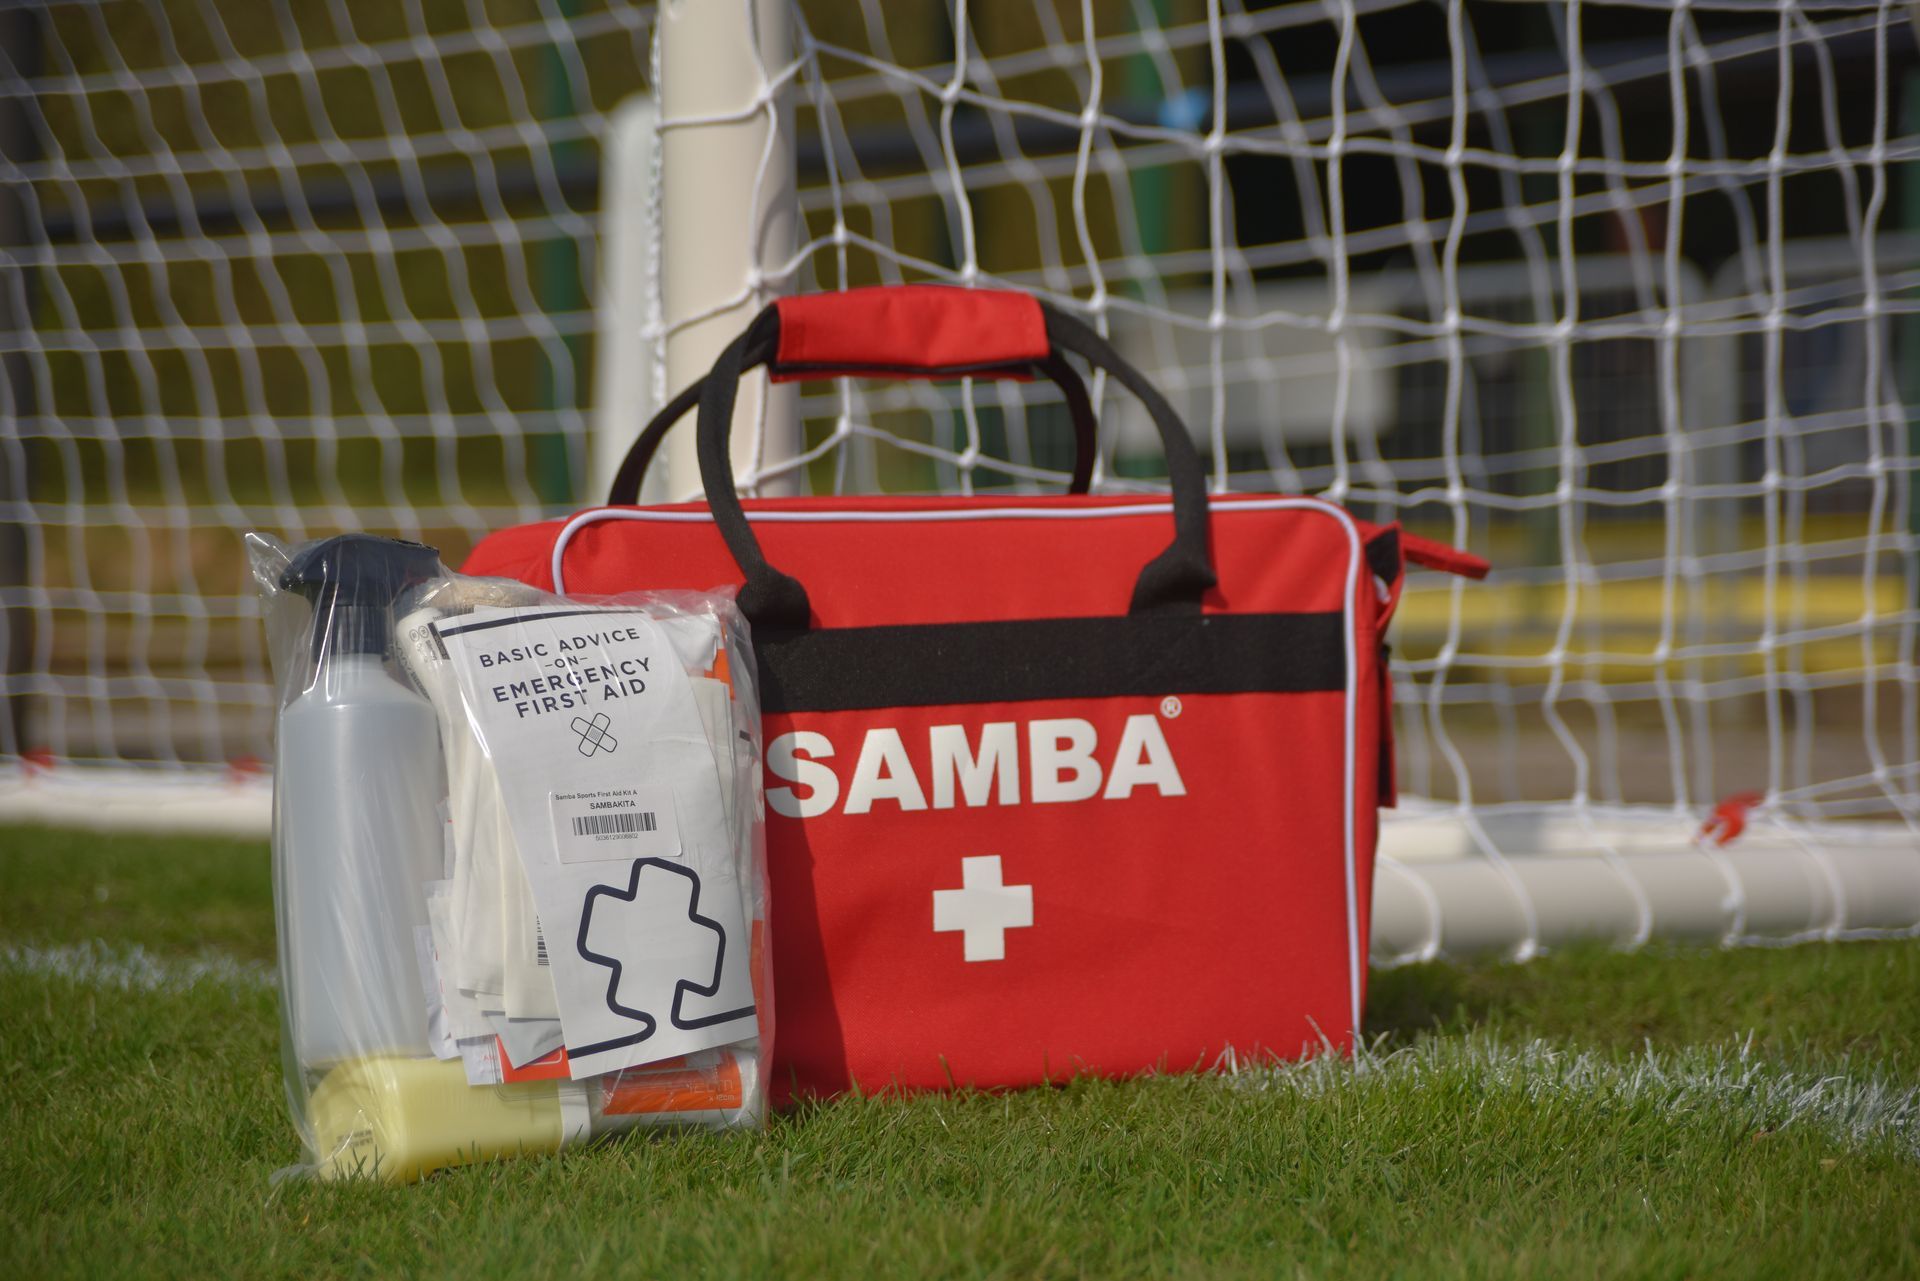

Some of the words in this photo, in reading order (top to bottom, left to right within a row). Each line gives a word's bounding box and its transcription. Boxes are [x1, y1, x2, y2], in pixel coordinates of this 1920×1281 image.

[479, 643, 548, 668] BASIC
[559, 628, 640, 652] ADVICE
[492, 657, 650, 703] EMERGENCY
[515, 689, 588, 718] FIRST
[603, 678, 646, 700] AID
[576, 792, 597, 800] Sports
[589, 800, 636, 810] SAMBAKITA
